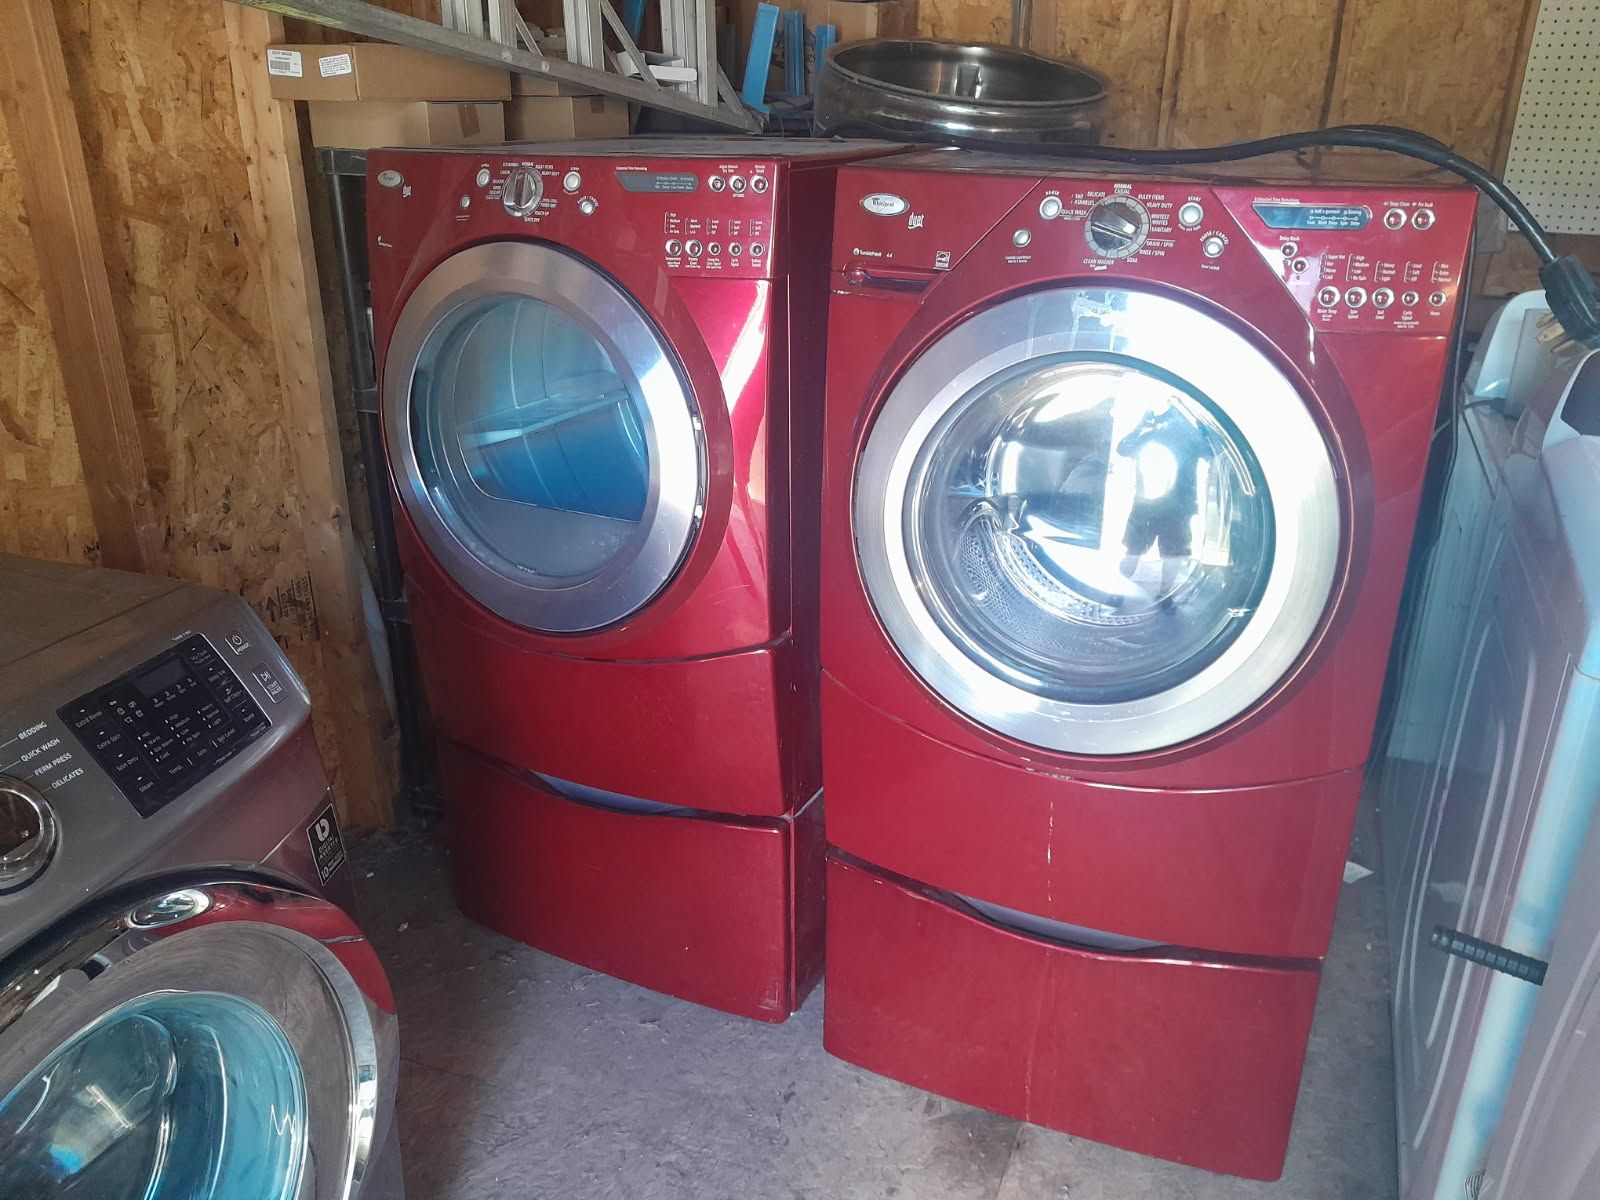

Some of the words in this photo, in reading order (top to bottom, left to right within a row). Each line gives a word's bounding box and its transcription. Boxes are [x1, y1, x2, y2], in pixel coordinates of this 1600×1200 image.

[18, 721, 48, 740] BEDDING
[20, 746, 42, 763] QUICK
[40, 737, 60, 753] WASH
[34, 761, 54, 777] PERM
[50, 752, 72, 768] PRESS
[51, 767, 84, 790] DELICATES
[321, 866, 329, 880] 10
